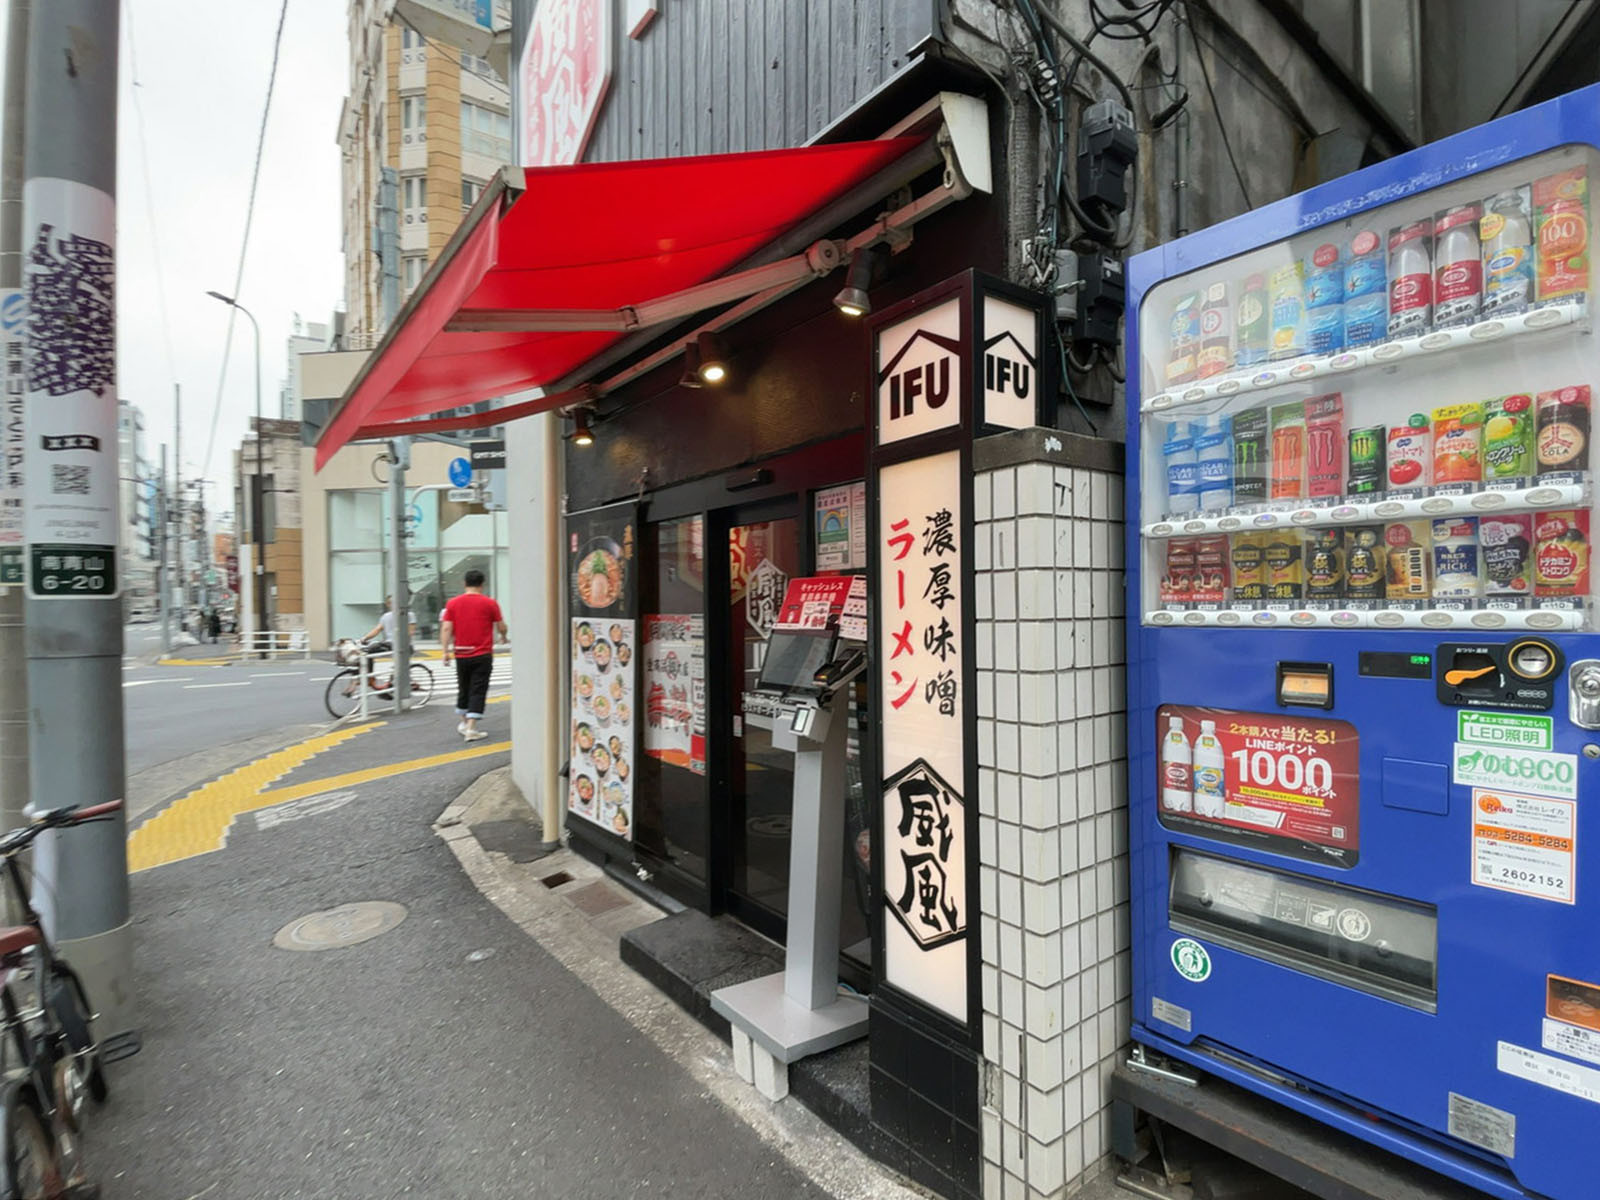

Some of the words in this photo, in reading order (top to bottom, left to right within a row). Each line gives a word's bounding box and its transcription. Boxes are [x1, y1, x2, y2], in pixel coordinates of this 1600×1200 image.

[986, 353, 1030, 400] IFU
[890, 357, 950, 421] IFU
[1543, 448, 1569, 457] COLA
[1439, 563, 1467, 571] RICH
[1540, 556, 1573, 566] ドデカミン
[1541, 566, 1572, 576] ストロング
[42, 575, 104, 590] 6-20
[887, 518, 918, 711] ラーメン
[922, 507, 957, 718] 濃厚味噌
[1229, 722, 1336, 744] 2本購入で当たる!
[1470, 726, 1540, 745] LED照明
[1245, 738, 1316, 756] LINEポイント
[1232, 749, 1332, 790] 1000
[1302, 785, 1337, 799] ポイント
[897, 773, 958, 932] 威風
[1502, 868, 1564, 889] 2602152
